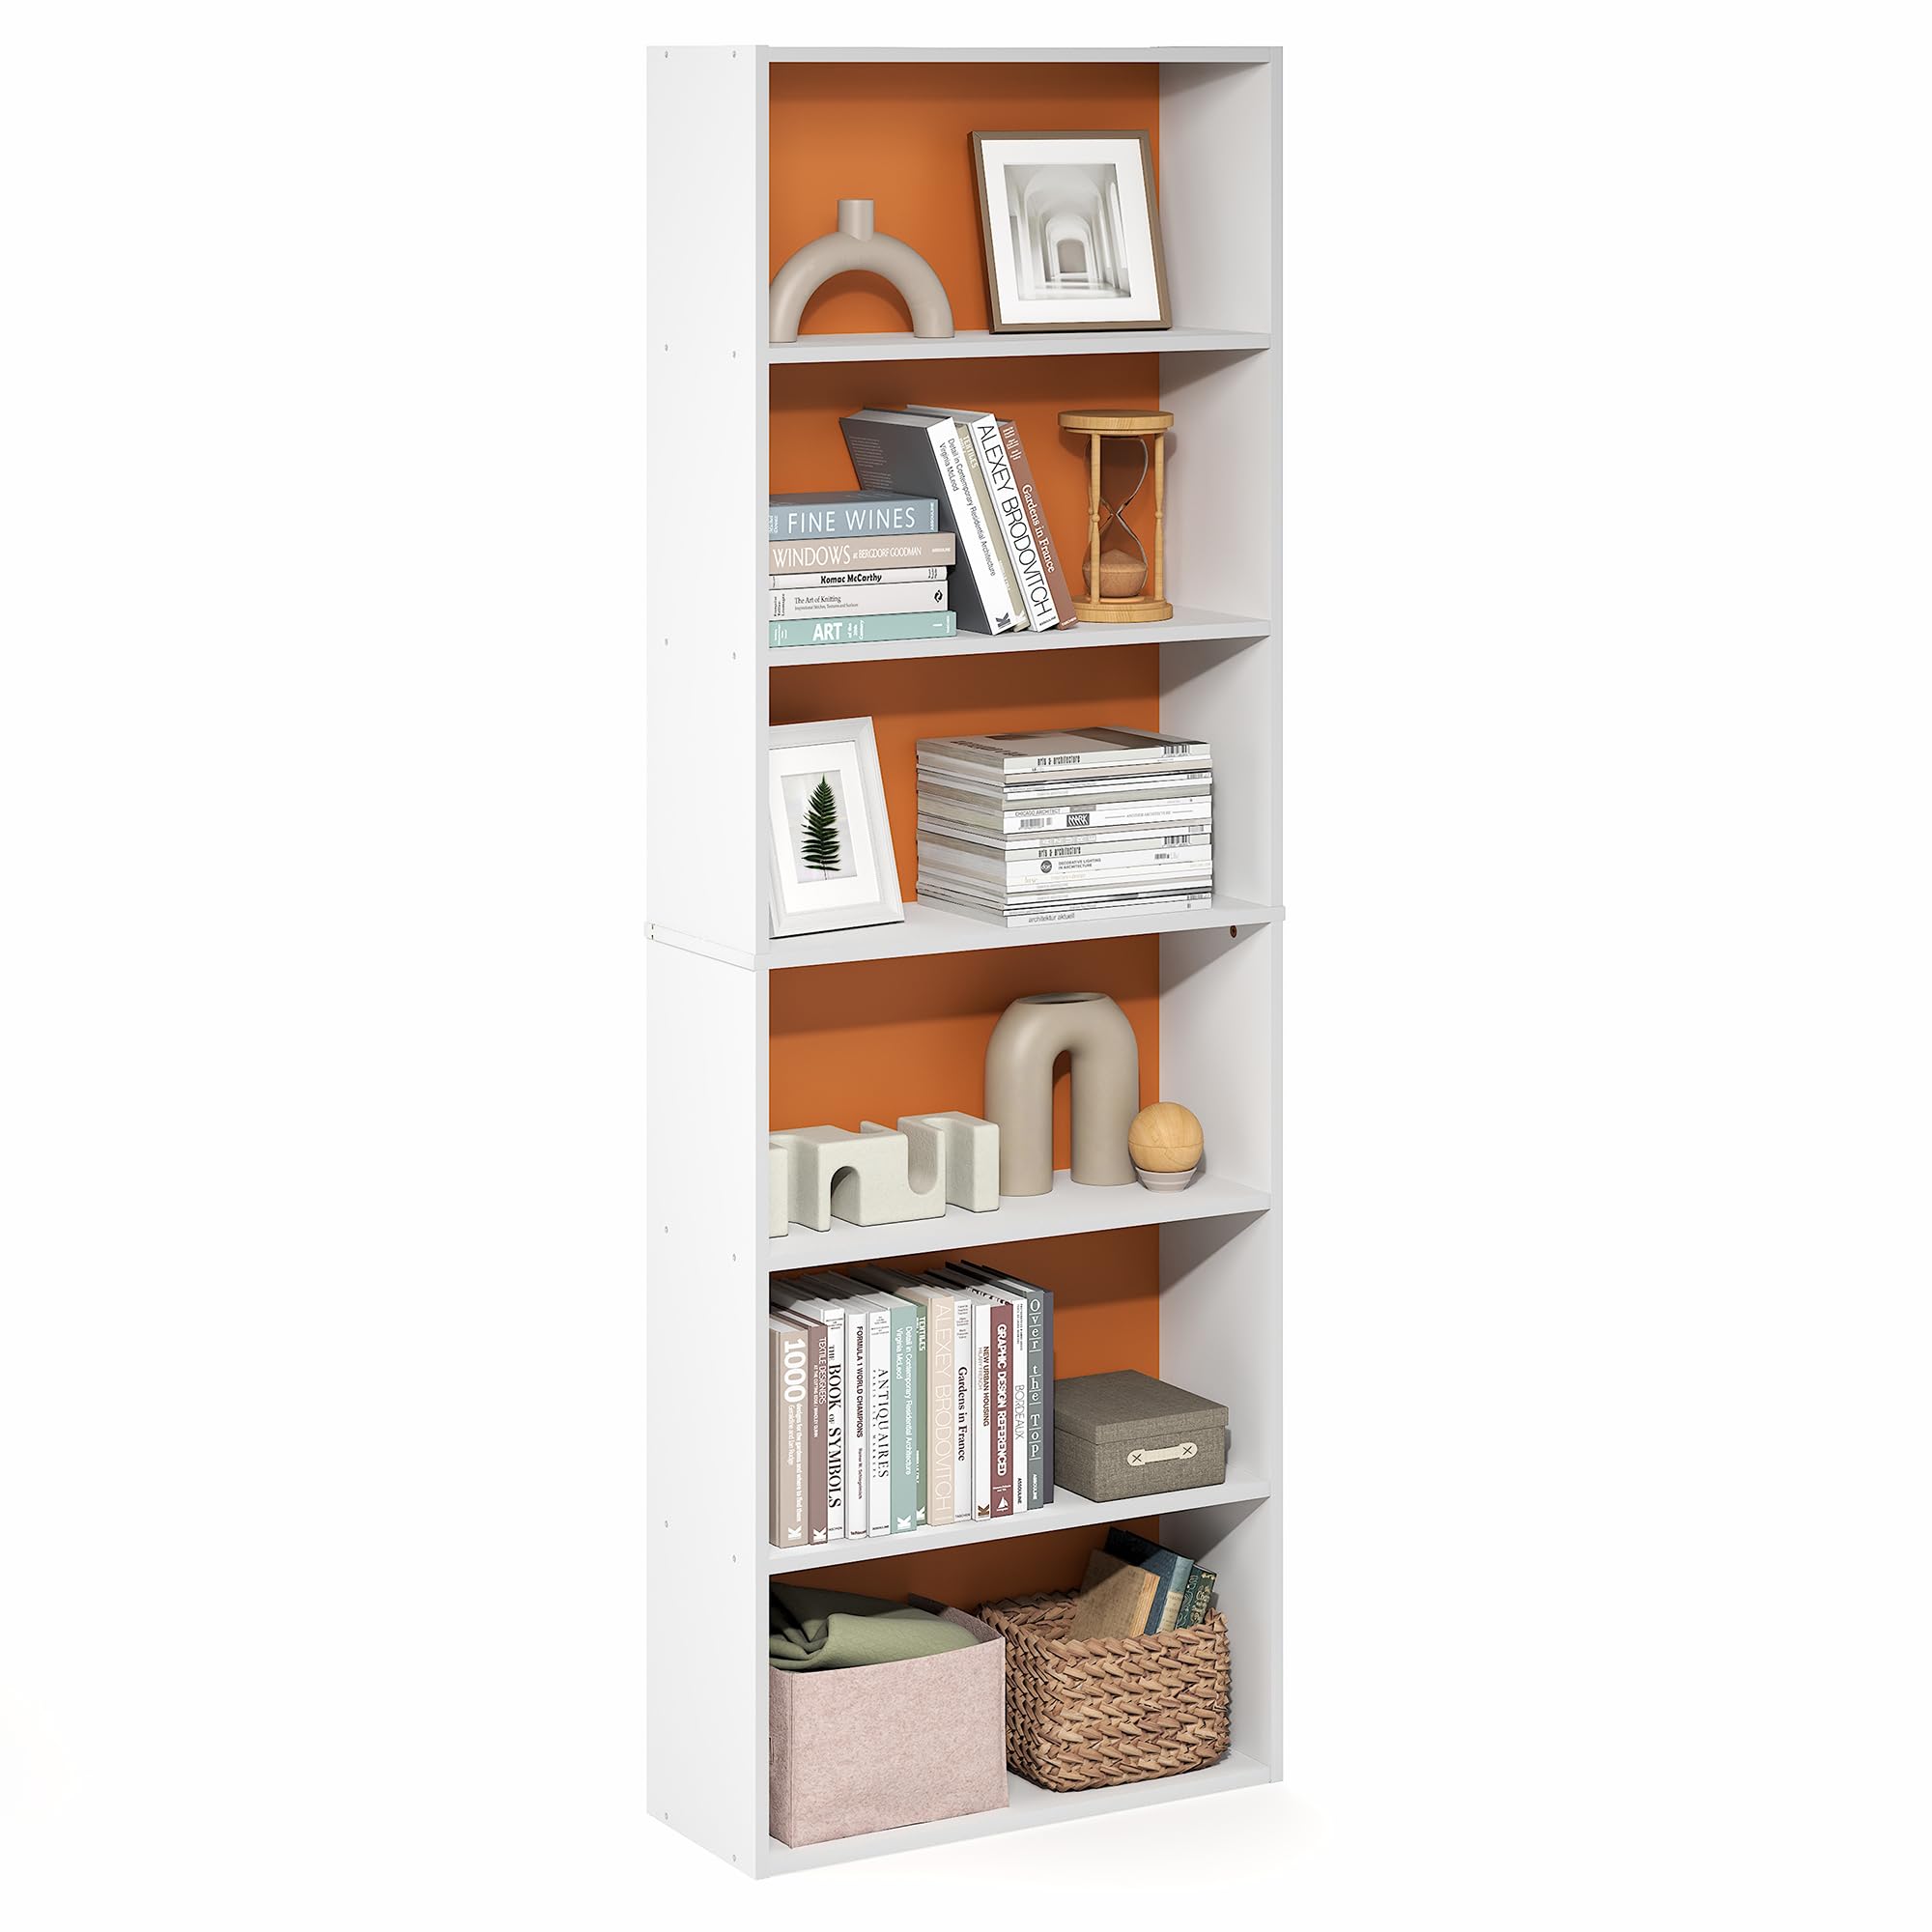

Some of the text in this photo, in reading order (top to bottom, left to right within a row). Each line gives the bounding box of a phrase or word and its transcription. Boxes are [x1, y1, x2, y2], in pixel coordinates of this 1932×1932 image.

[940, 442, 959, 492] Virginia McLeod
[948, 438, 957, 455] Detail
[954, 456, 960, 465] in
[956, 464, 974, 507] Contemporary
[788, 507, 916, 534] FINE WINES
[970, 506, 985, 540] Residential
[978, 426, 1014, 491] ALEXEY
[1001, 496, 1053, 617] BRODOVITCH
[1022, 484, 1055, 574] Gardens in France
[772, 545, 851, 568] WINDOWS
[858, 548, 890, 559] BERGDORF
[890, 547, 923, 557] GOODMAN
[847, 573, 883, 582] McCarthy
[981, 540, 996, 577] Architecture
[820, 595, 841, 604] Knitting
[812, 622, 843, 641] ART
[1053, 754, 1080, 765] architecture
[1054, 846, 1081, 857] architecture
[1028, 915, 1057, 923] architektur
[895, 1327, 903, 1352] Virginia
[934, 1304, 952, 1378] ALEXEY
[997, 1323, 1007, 1370] GRAPHIC
[783, 1338, 807, 1403] 1000
[828, 1364, 841, 1410] BOOK
[904, 1353, 913, 1399] Contemporary
[997, 1371, 1007, 1408] DESIGN
[876, 1368, 889, 1478] ANTIQUAIRES
[958, 1367, 968, 1462] Gardens in France
[1014, 1384, 1024, 1440] BORDEAUX
[934, 1384, 952, 1511] BRODOVITCH
[997, 1410, 1007, 1476] REFERENCED
[828, 1427, 841, 1509] SYMBOLS
